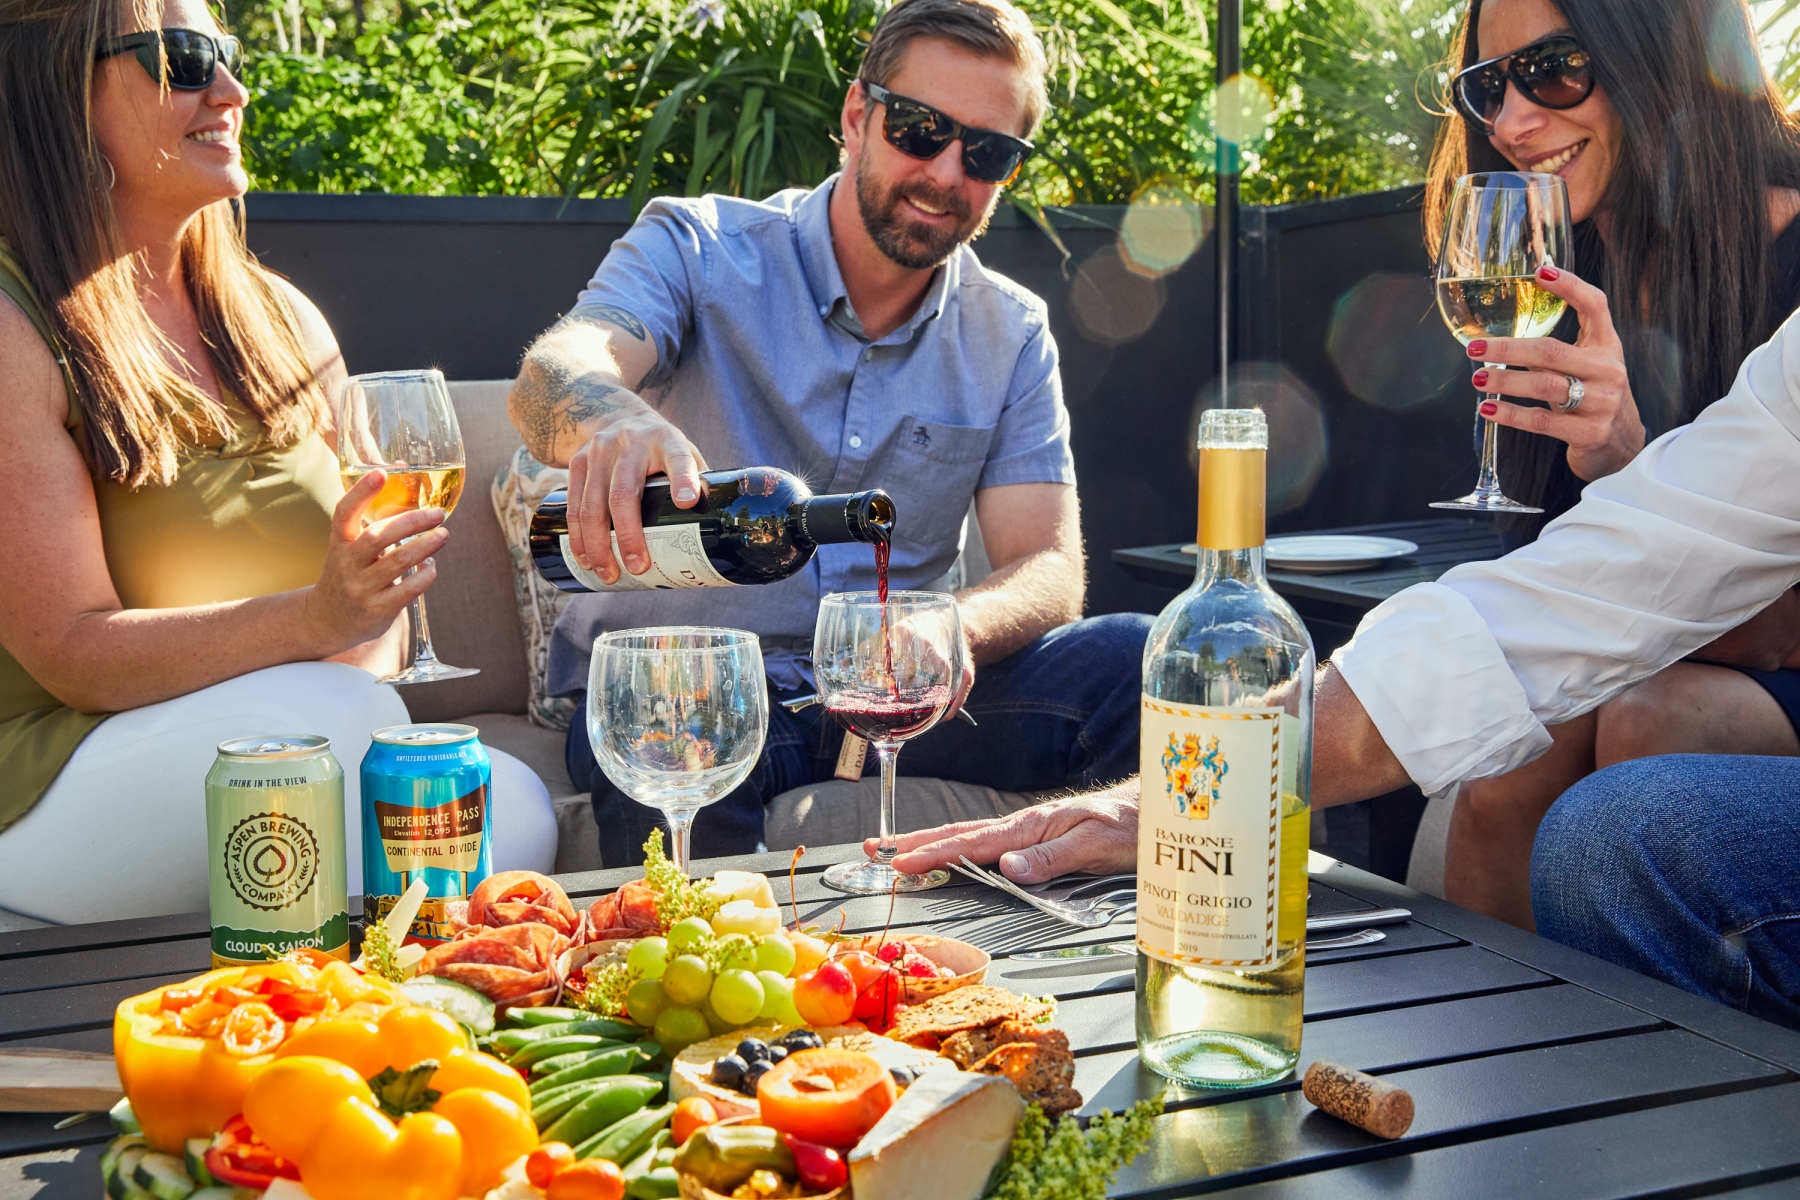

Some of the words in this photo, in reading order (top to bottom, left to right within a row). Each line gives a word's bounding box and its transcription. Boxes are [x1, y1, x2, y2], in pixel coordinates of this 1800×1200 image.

[228, 779, 251, 788] DRINK
[254, 779, 263, 788] IN
[266, 778, 283, 787] THE
[285, 776, 308, 786] VIEW
[383, 812, 451, 828] INDEPENDENCE
[456, 805, 480, 823] PASS
[231, 824, 258, 862] ASPEN
[260, 820, 312, 859] BREWING
[386, 846, 443, 857] CONTINENTAL
[449, 841, 477, 855] DIVIDE
[1156, 827, 1235, 849] BARONE
[1155, 841, 1234, 876] FINI
[242, 879, 301, 902] COMPANY
[1143, 880, 1180, 902] PINOT
[1187, 892, 1253, 909] GRIGIO
[225, 940, 262, 954] CLOUD
[279, 935, 324, 953] SAISON
[1178, 942, 1199, 953] 2019
